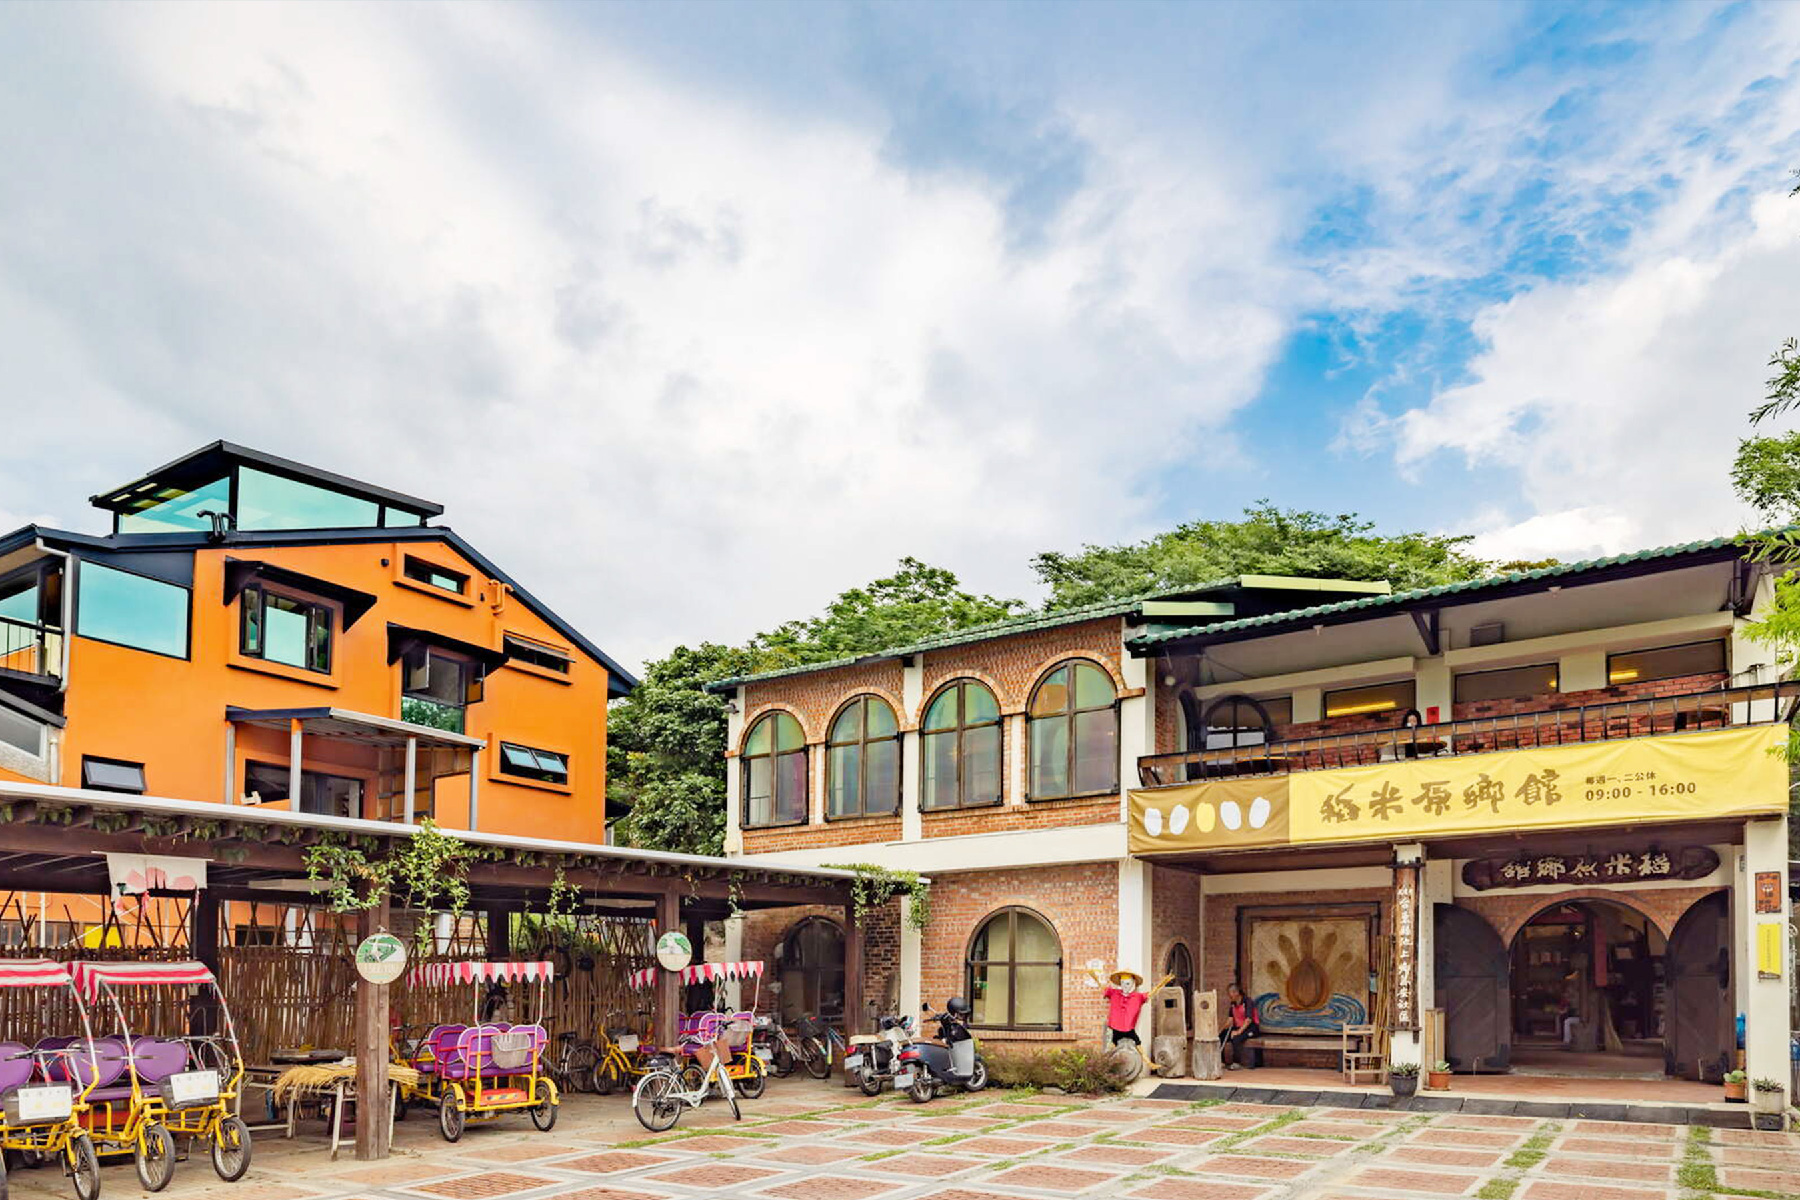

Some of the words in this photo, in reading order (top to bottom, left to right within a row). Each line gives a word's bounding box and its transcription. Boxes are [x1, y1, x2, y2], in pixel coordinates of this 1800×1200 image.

[1320, 768, 1563, 824] 稻米原鄉館
[1585, 786, 1632, 801] 09:00
[1649, 782, 1696, 797] 16:00
